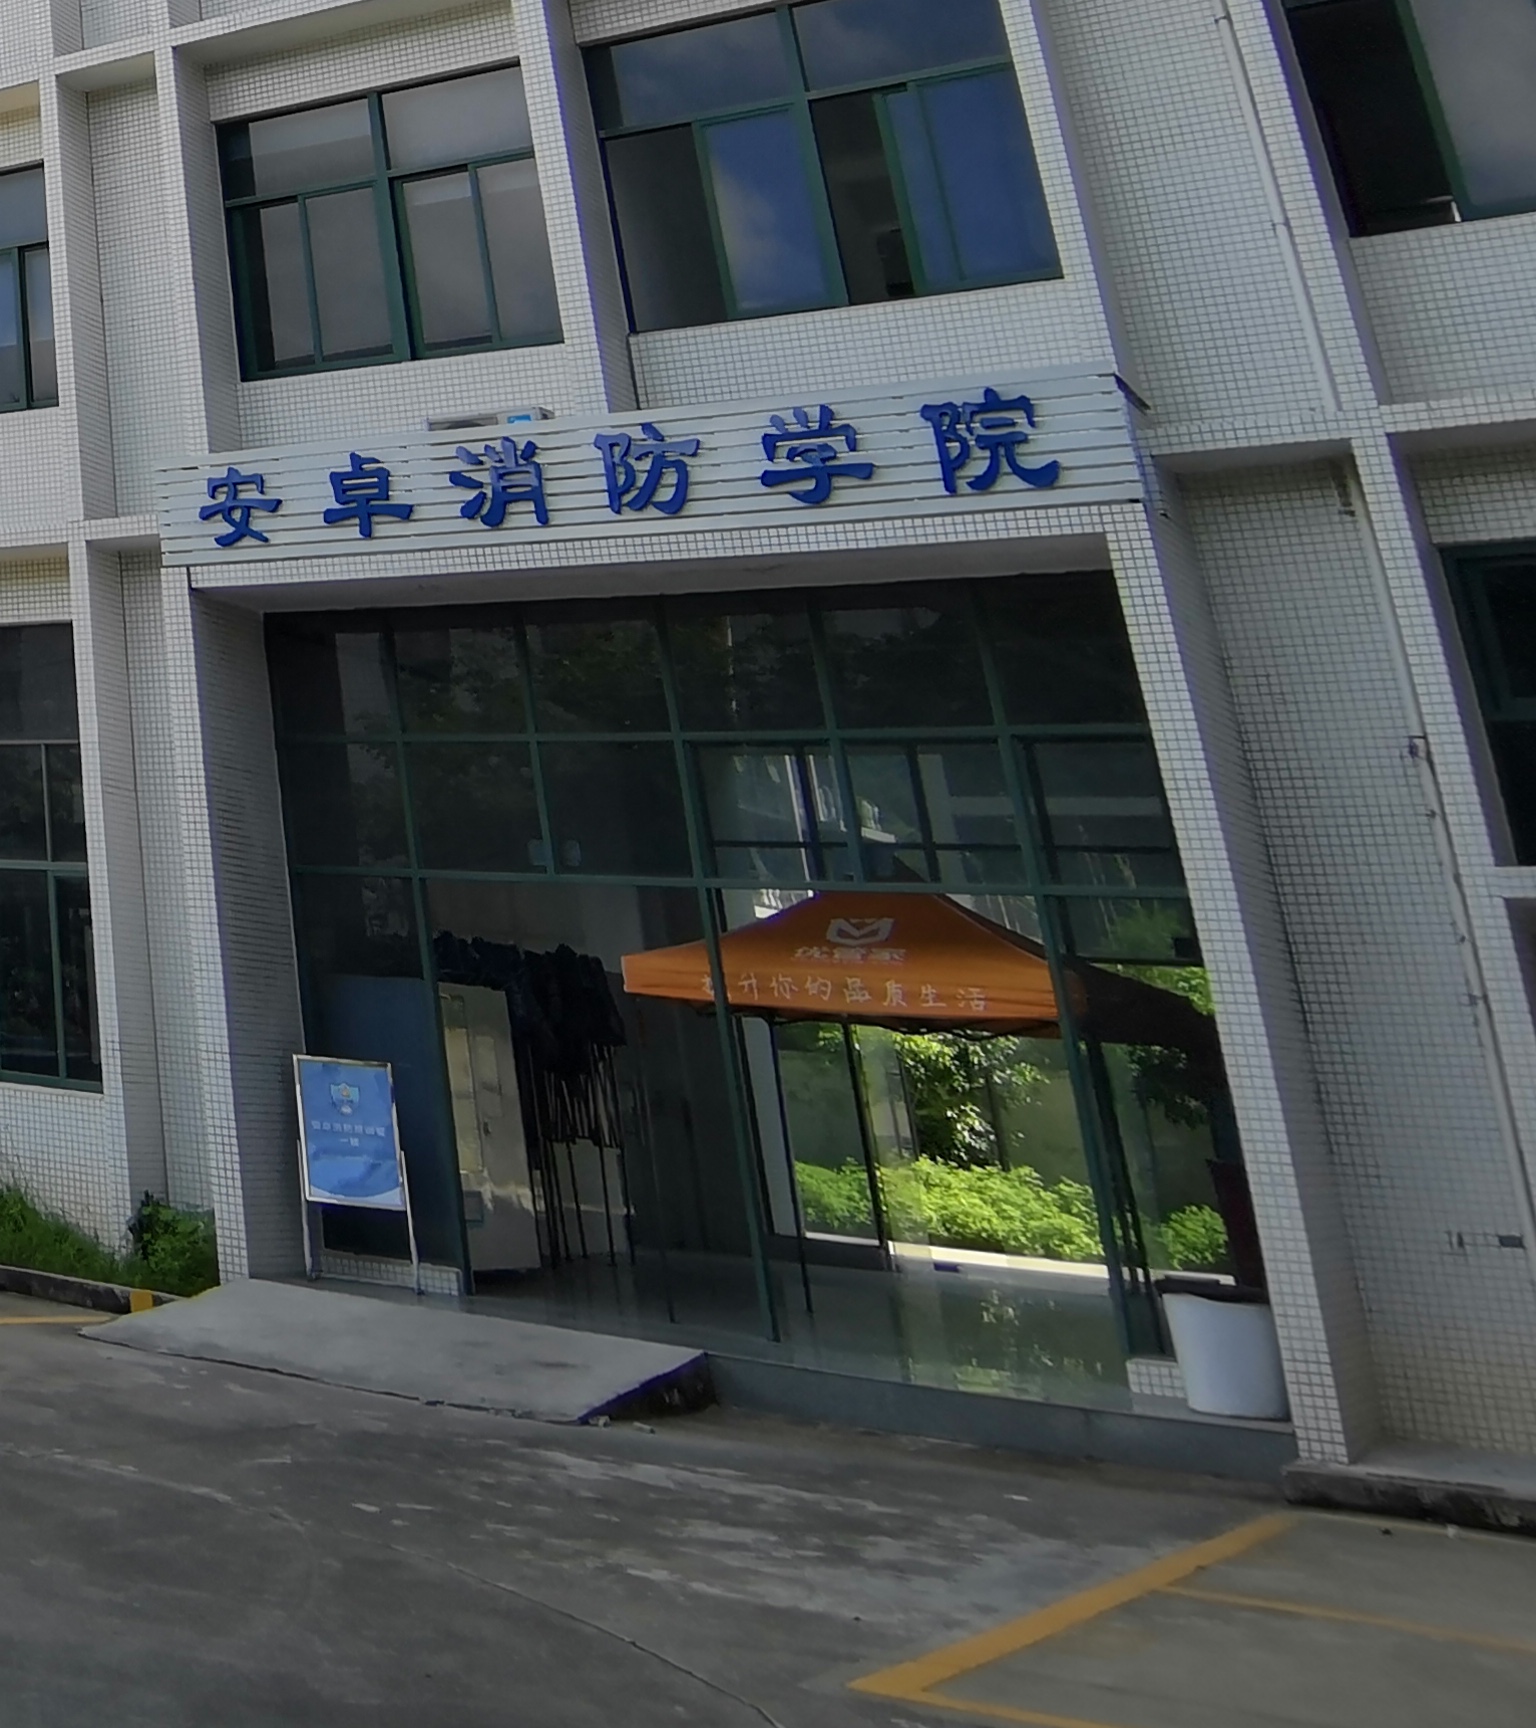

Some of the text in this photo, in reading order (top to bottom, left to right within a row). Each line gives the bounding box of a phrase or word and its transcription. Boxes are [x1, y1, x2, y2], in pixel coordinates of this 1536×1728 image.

[199, 387, 1060, 547] 安卓消防学院
